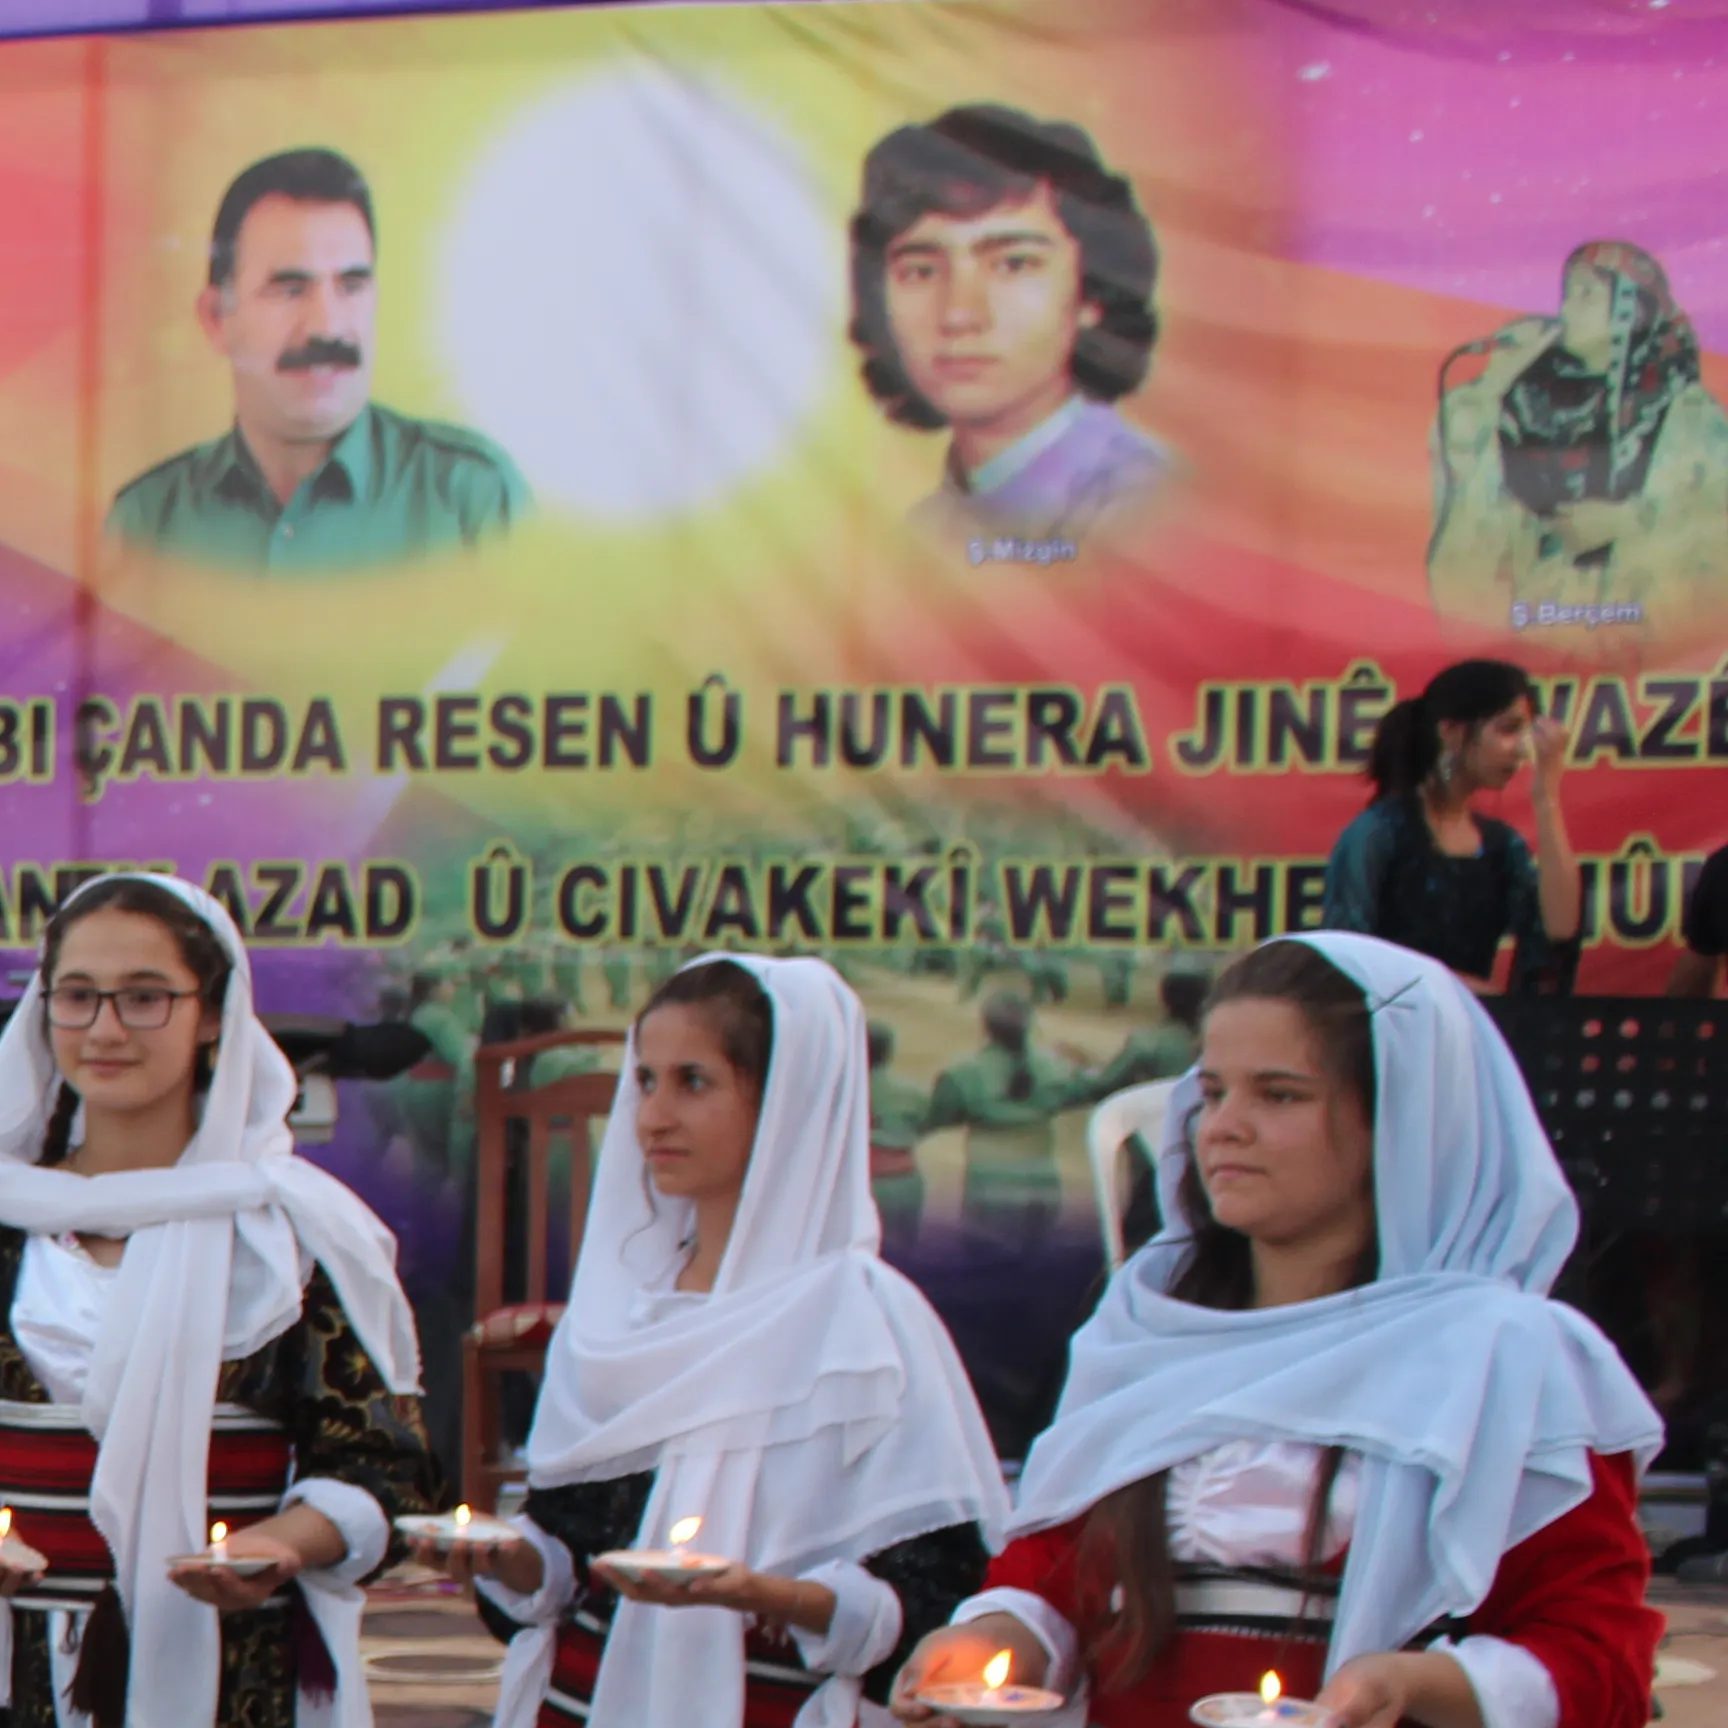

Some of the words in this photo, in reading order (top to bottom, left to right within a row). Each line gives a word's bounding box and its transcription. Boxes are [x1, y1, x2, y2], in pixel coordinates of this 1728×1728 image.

[73, 697, 349, 798] ÇANDA
[375, 691, 653, 771] RESEN
[686, 671, 741, 770] Û
[775, 687, 1147, 770] HUNERA
[1174, 664, 1392, 770] JINÊ
[471, 845, 527, 941] Û
[556, 844, 974, 941] CIVAKEKÎ
